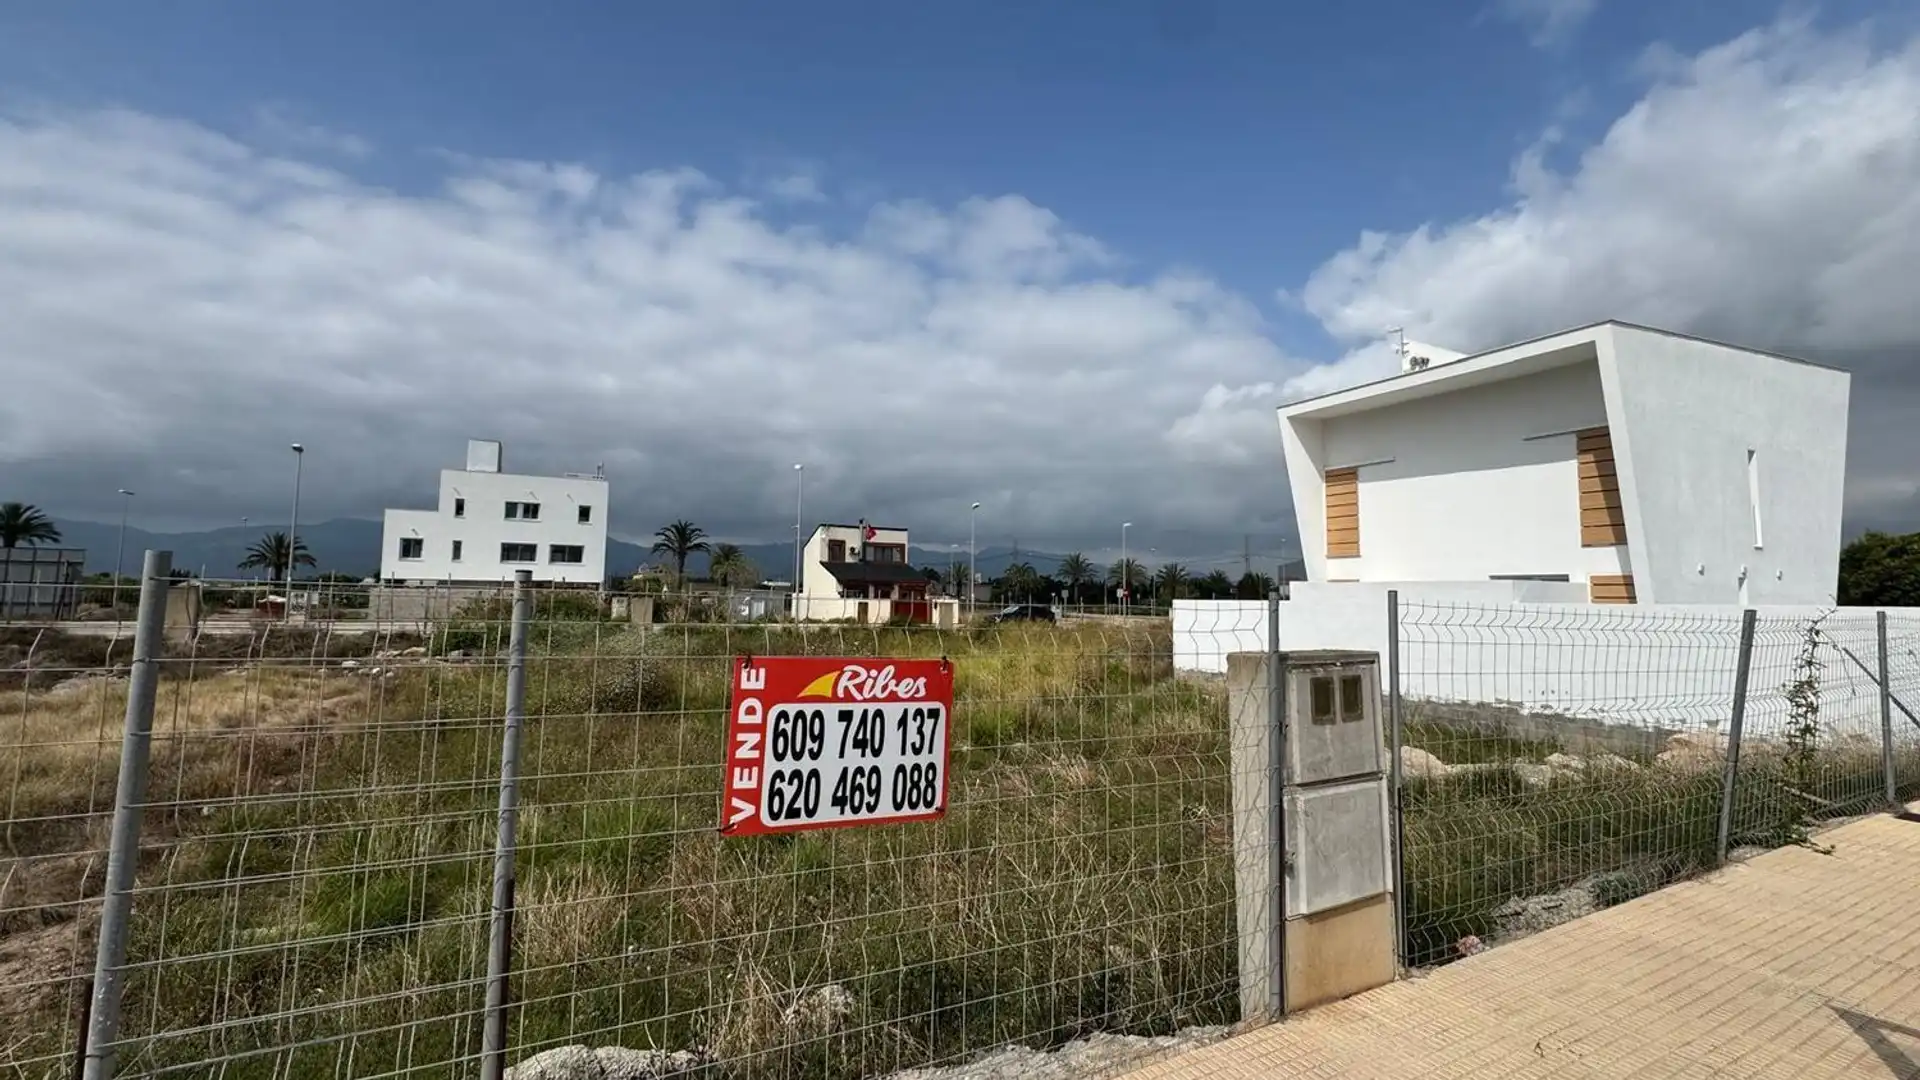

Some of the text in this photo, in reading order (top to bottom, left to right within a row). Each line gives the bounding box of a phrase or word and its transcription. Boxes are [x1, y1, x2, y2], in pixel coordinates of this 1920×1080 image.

[836, 664, 927, 700] Ribes
[730, 667, 766, 824] VENDE
[772, 707, 941, 762] 609 740 137
[767, 761, 938, 822] 620 469 088
